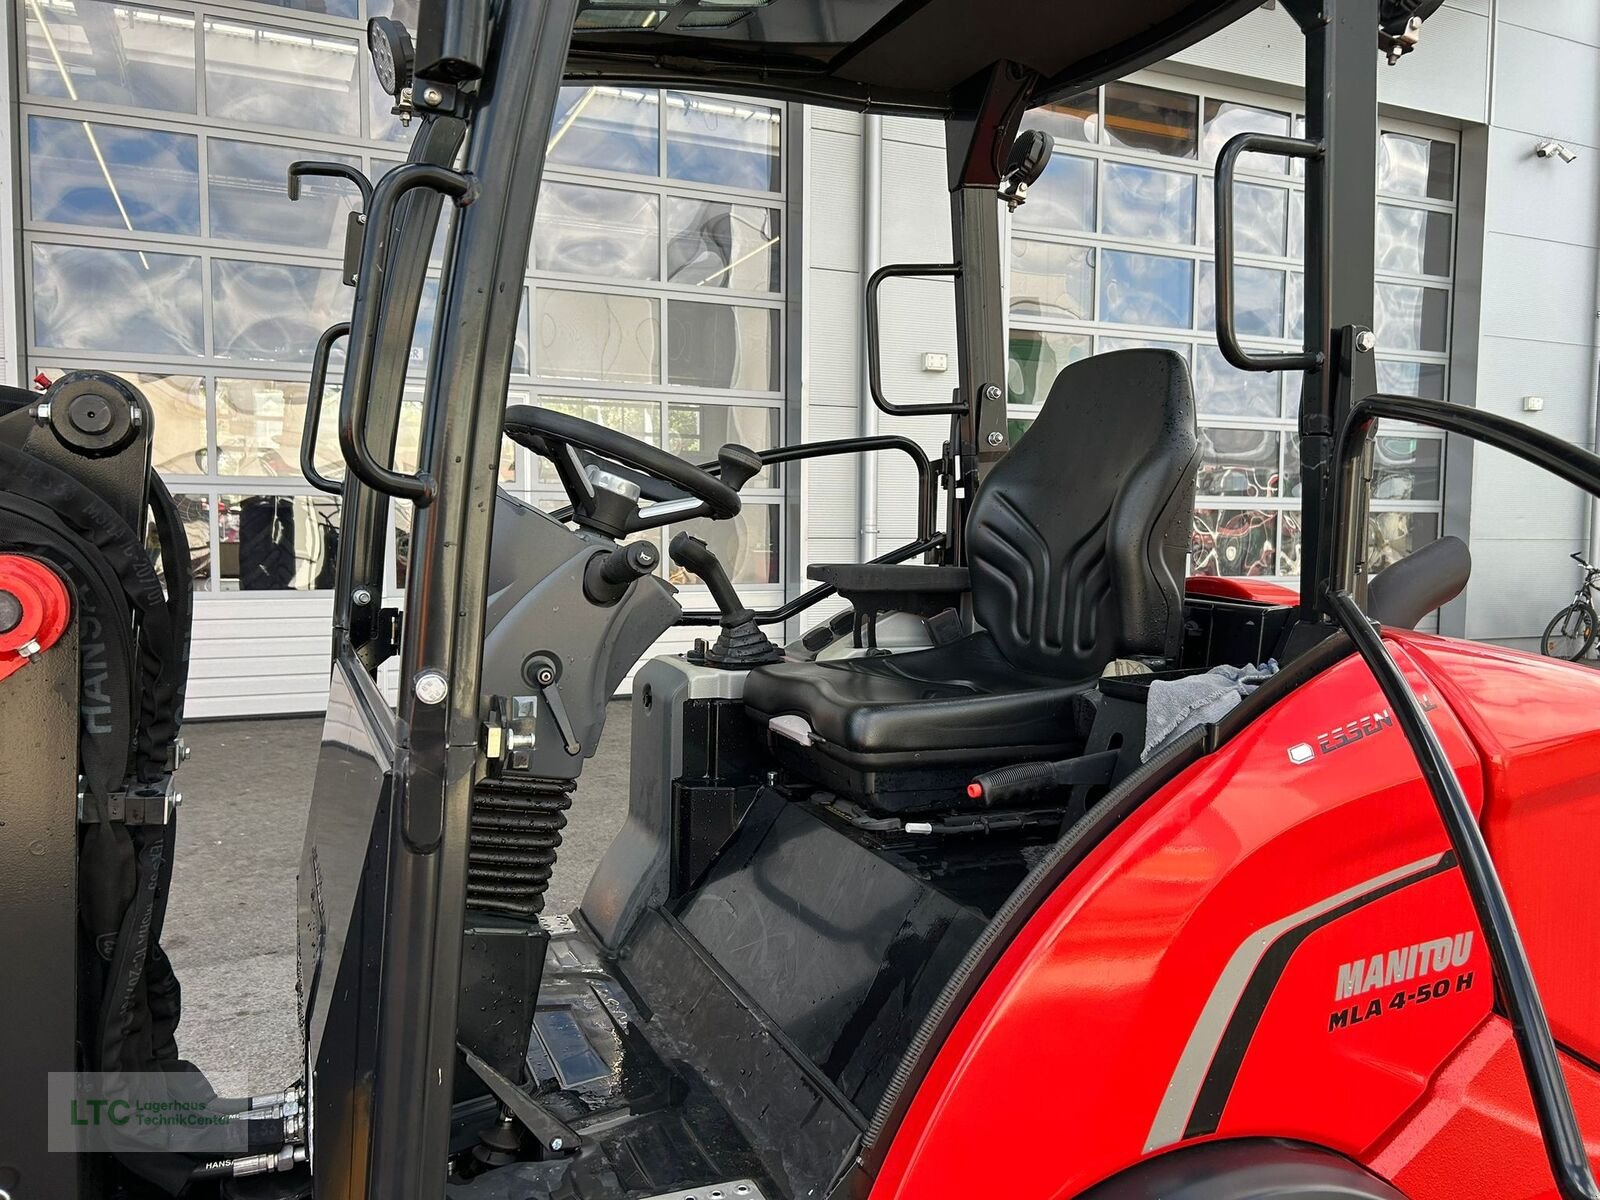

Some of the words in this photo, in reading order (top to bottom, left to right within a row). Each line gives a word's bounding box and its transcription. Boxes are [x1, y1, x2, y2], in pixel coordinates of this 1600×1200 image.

[1334, 931, 1474, 1002] MANITOU
[1328, 998, 1382, 1033] MLA
[1389, 978, 1450, 1011] 4-50
[1455, 971, 1474, 993] H
